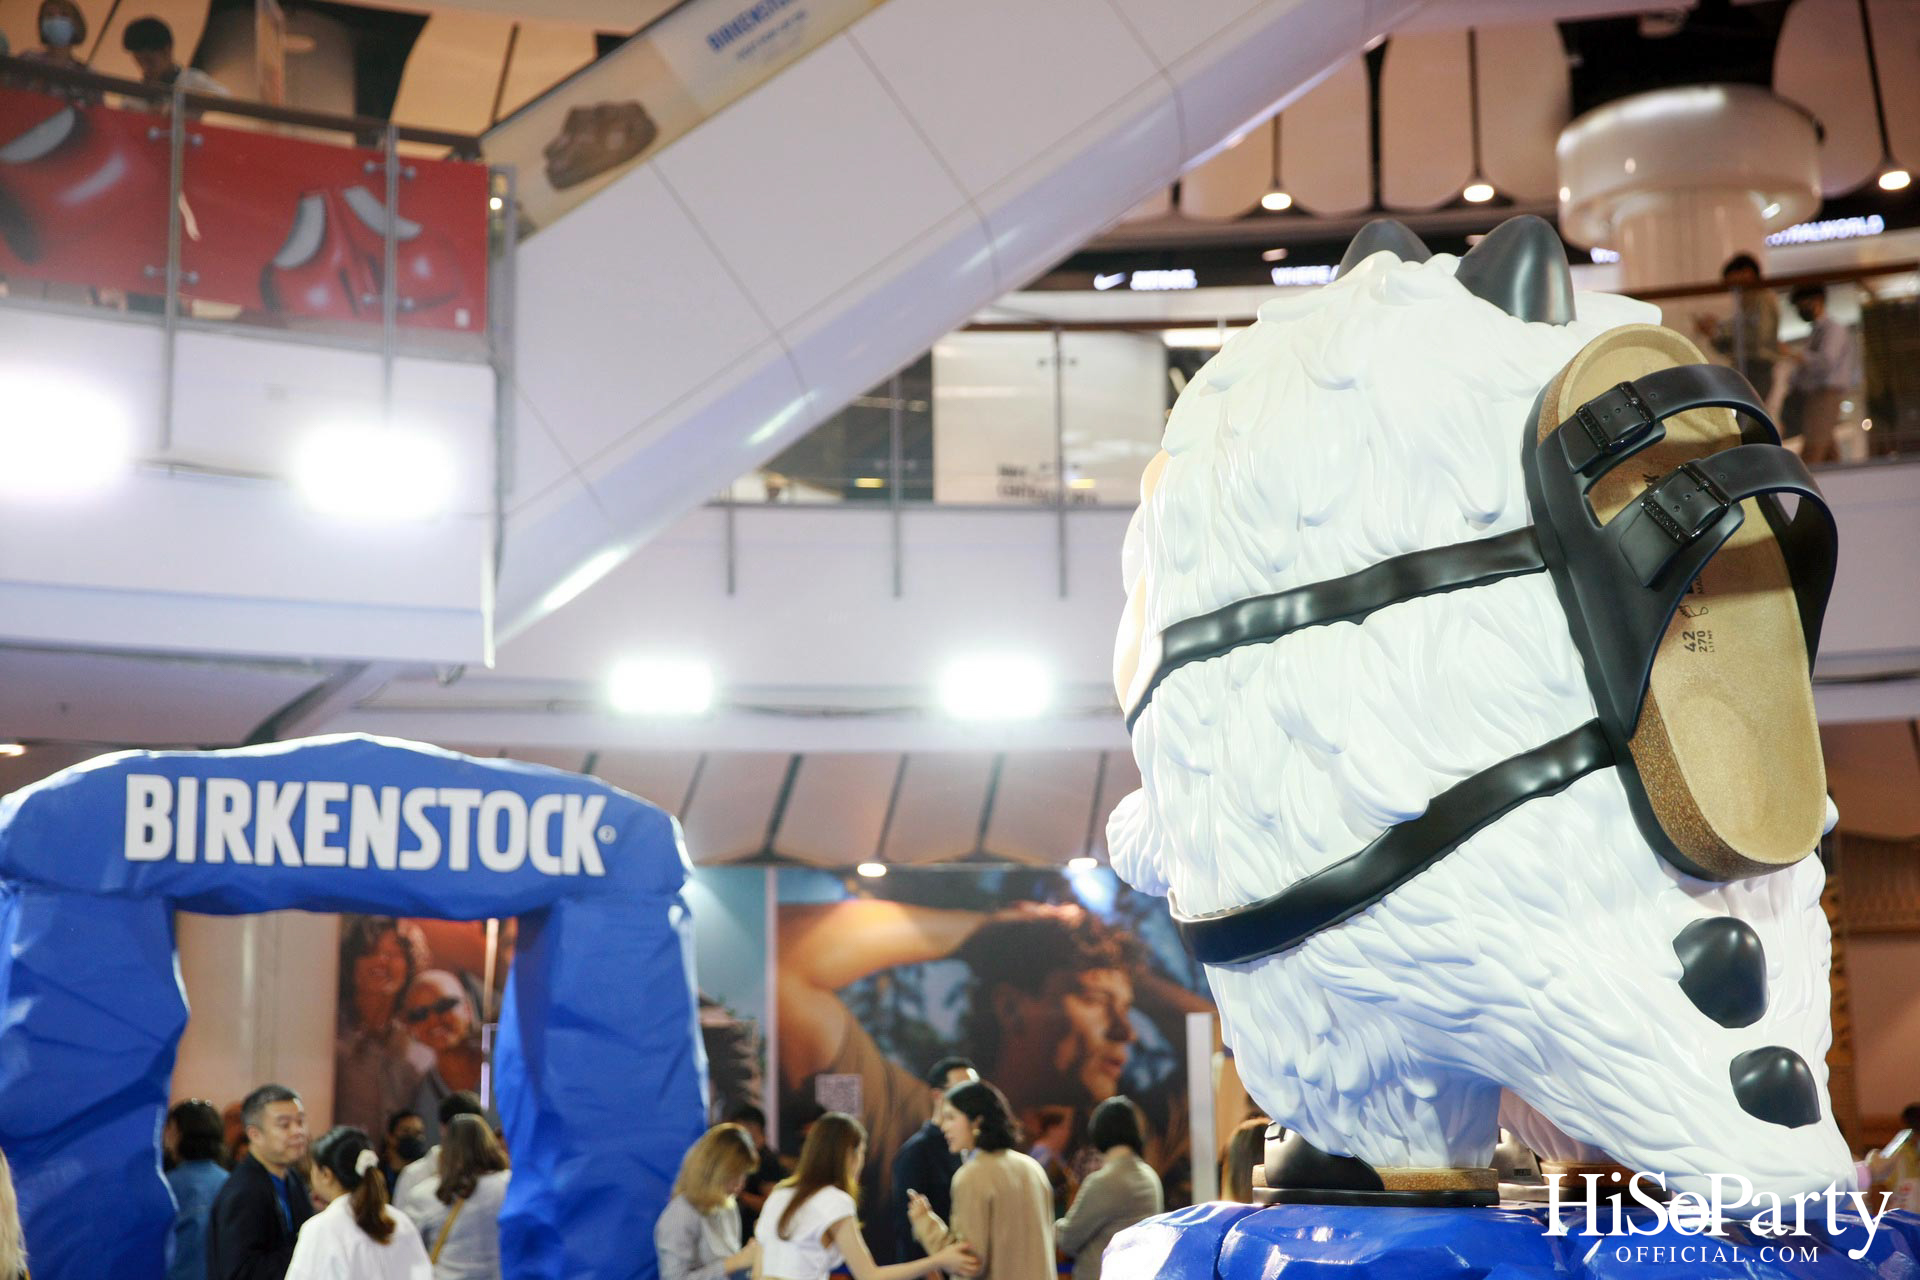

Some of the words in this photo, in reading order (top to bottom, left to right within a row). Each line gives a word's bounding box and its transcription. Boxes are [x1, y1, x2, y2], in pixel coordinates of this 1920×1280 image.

[1682, 631, 1696, 652] 42
[1697, 630, 1707, 652] 270
[124, 773, 607, 877] BIRKENSTOCK
